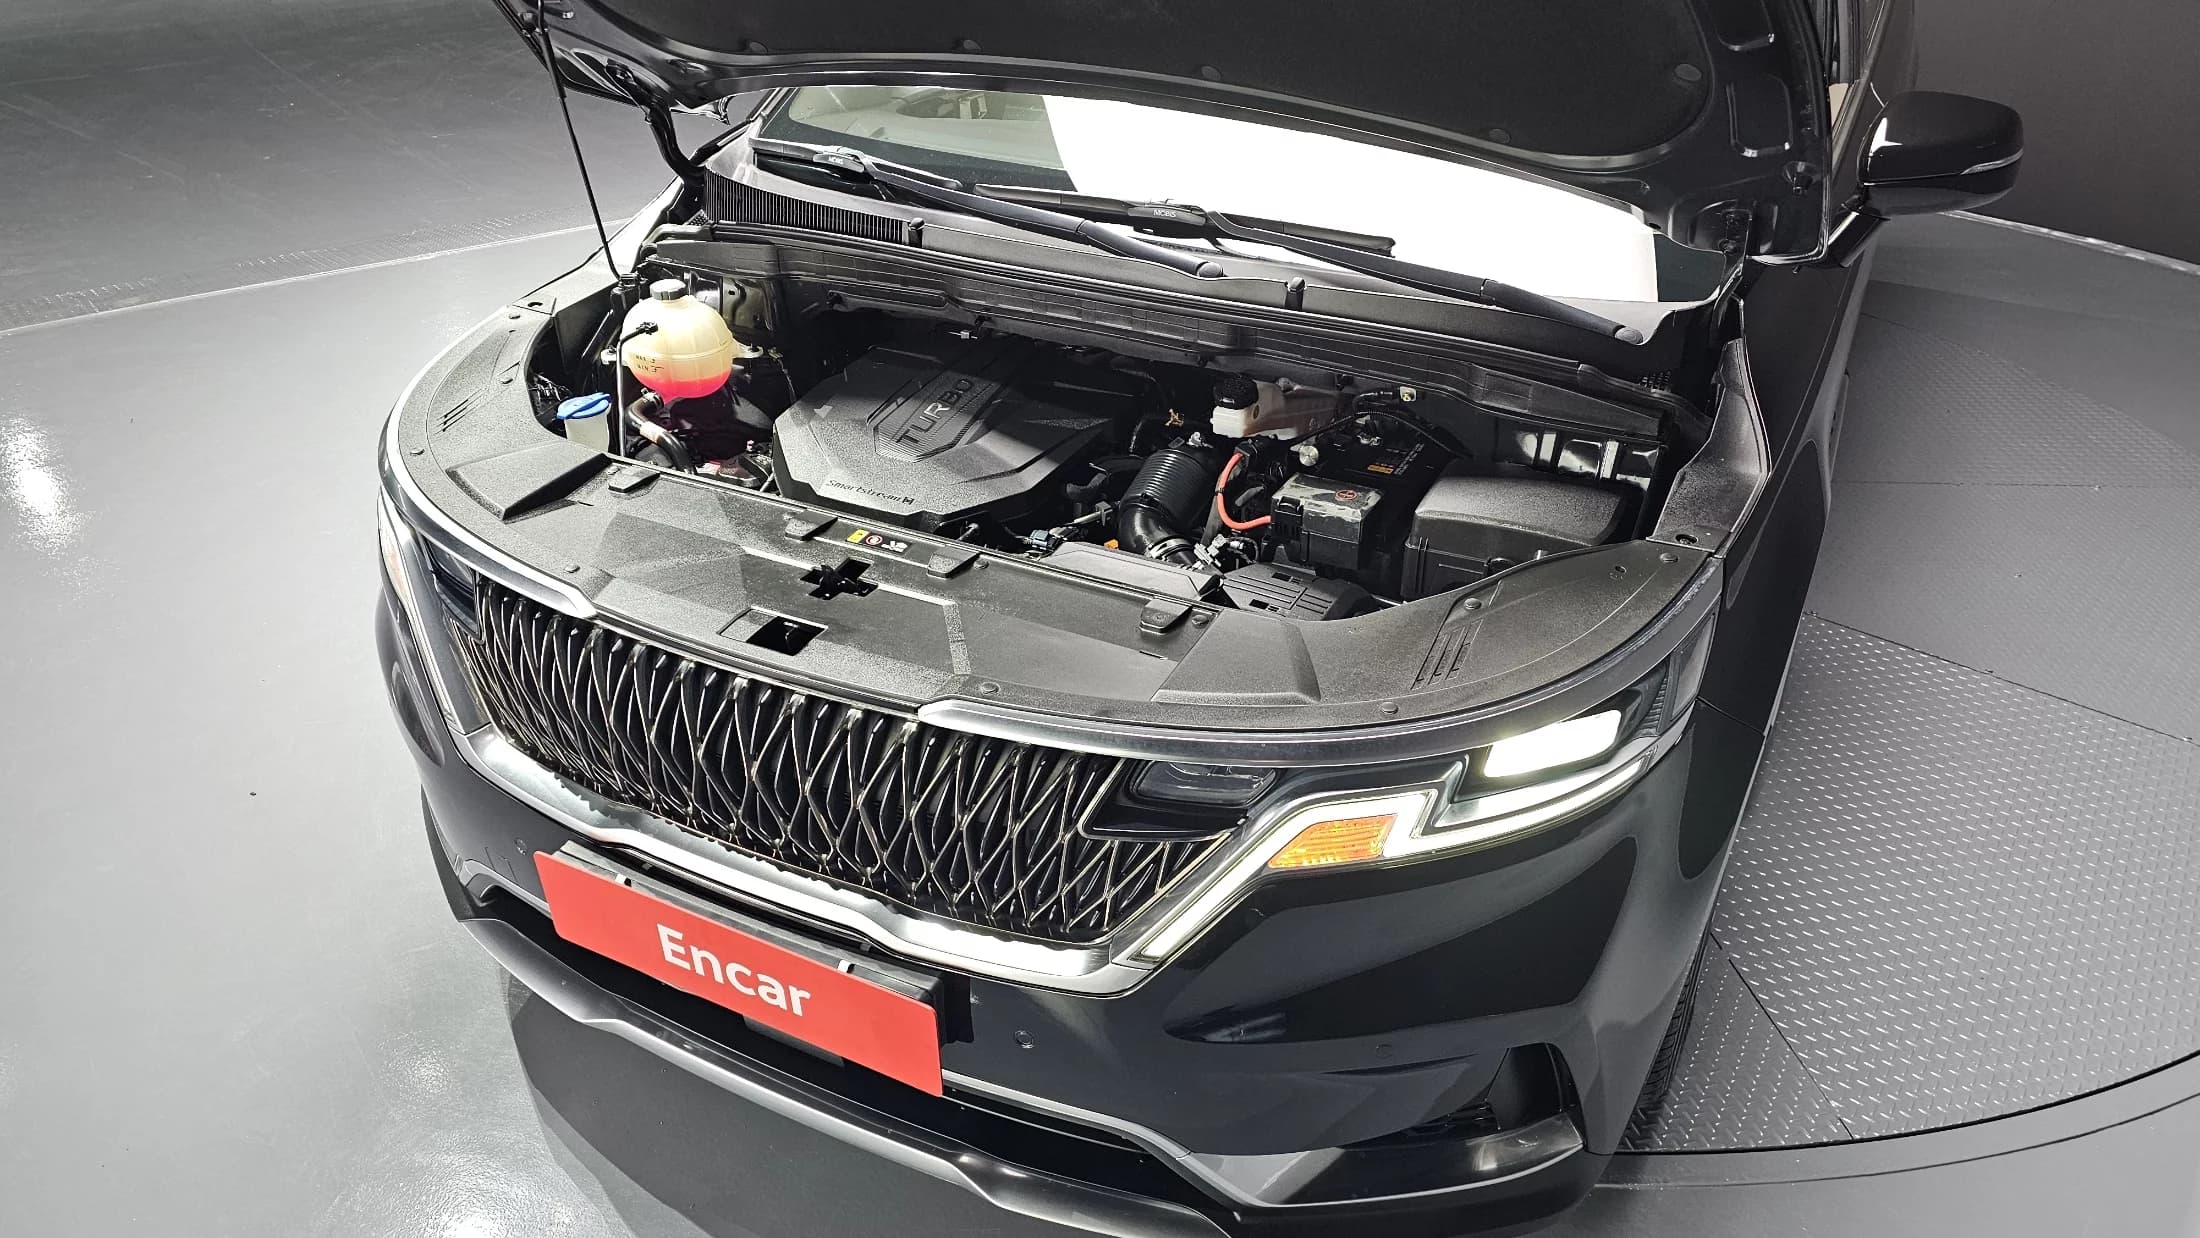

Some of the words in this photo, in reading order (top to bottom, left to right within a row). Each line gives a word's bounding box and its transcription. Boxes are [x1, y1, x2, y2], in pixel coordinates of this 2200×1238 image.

[896, 379, 974, 444] TURBO
[828, 479, 902, 502] Smartstream
[656, 922, 811, 1017] Encar
